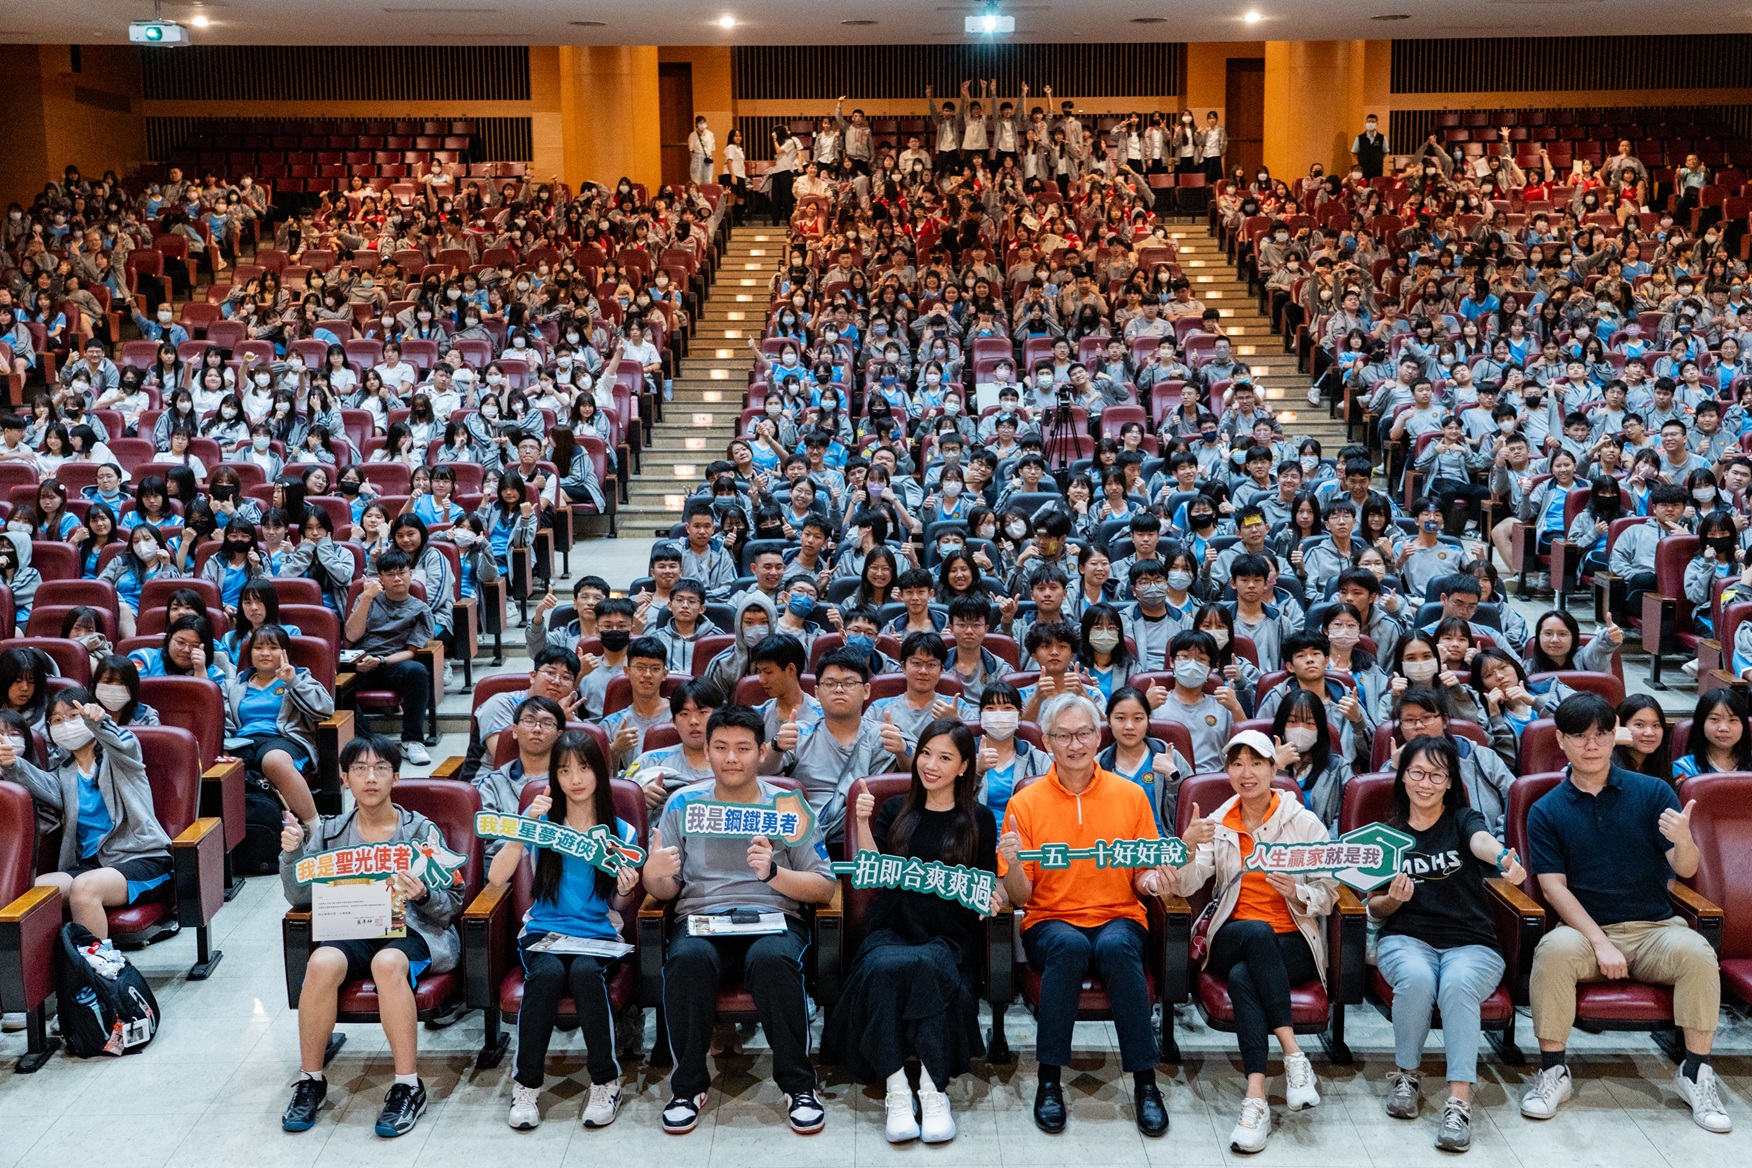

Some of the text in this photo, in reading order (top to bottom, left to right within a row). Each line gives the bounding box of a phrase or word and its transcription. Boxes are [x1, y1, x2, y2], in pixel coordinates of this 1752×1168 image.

[687, 806, 797, 834] 我是鋼鐵勇者
[479, 816, 597, 859] 我是星夢遊俠
[298, 845, 411, 880] 我是聖光使者
[1020, 842, 1183, 865] 一五一十好好說
[1250, 847, 1381, 868] 人生贏家就是我
[833, 853, 992, 913] 一拍即合爽爽過
